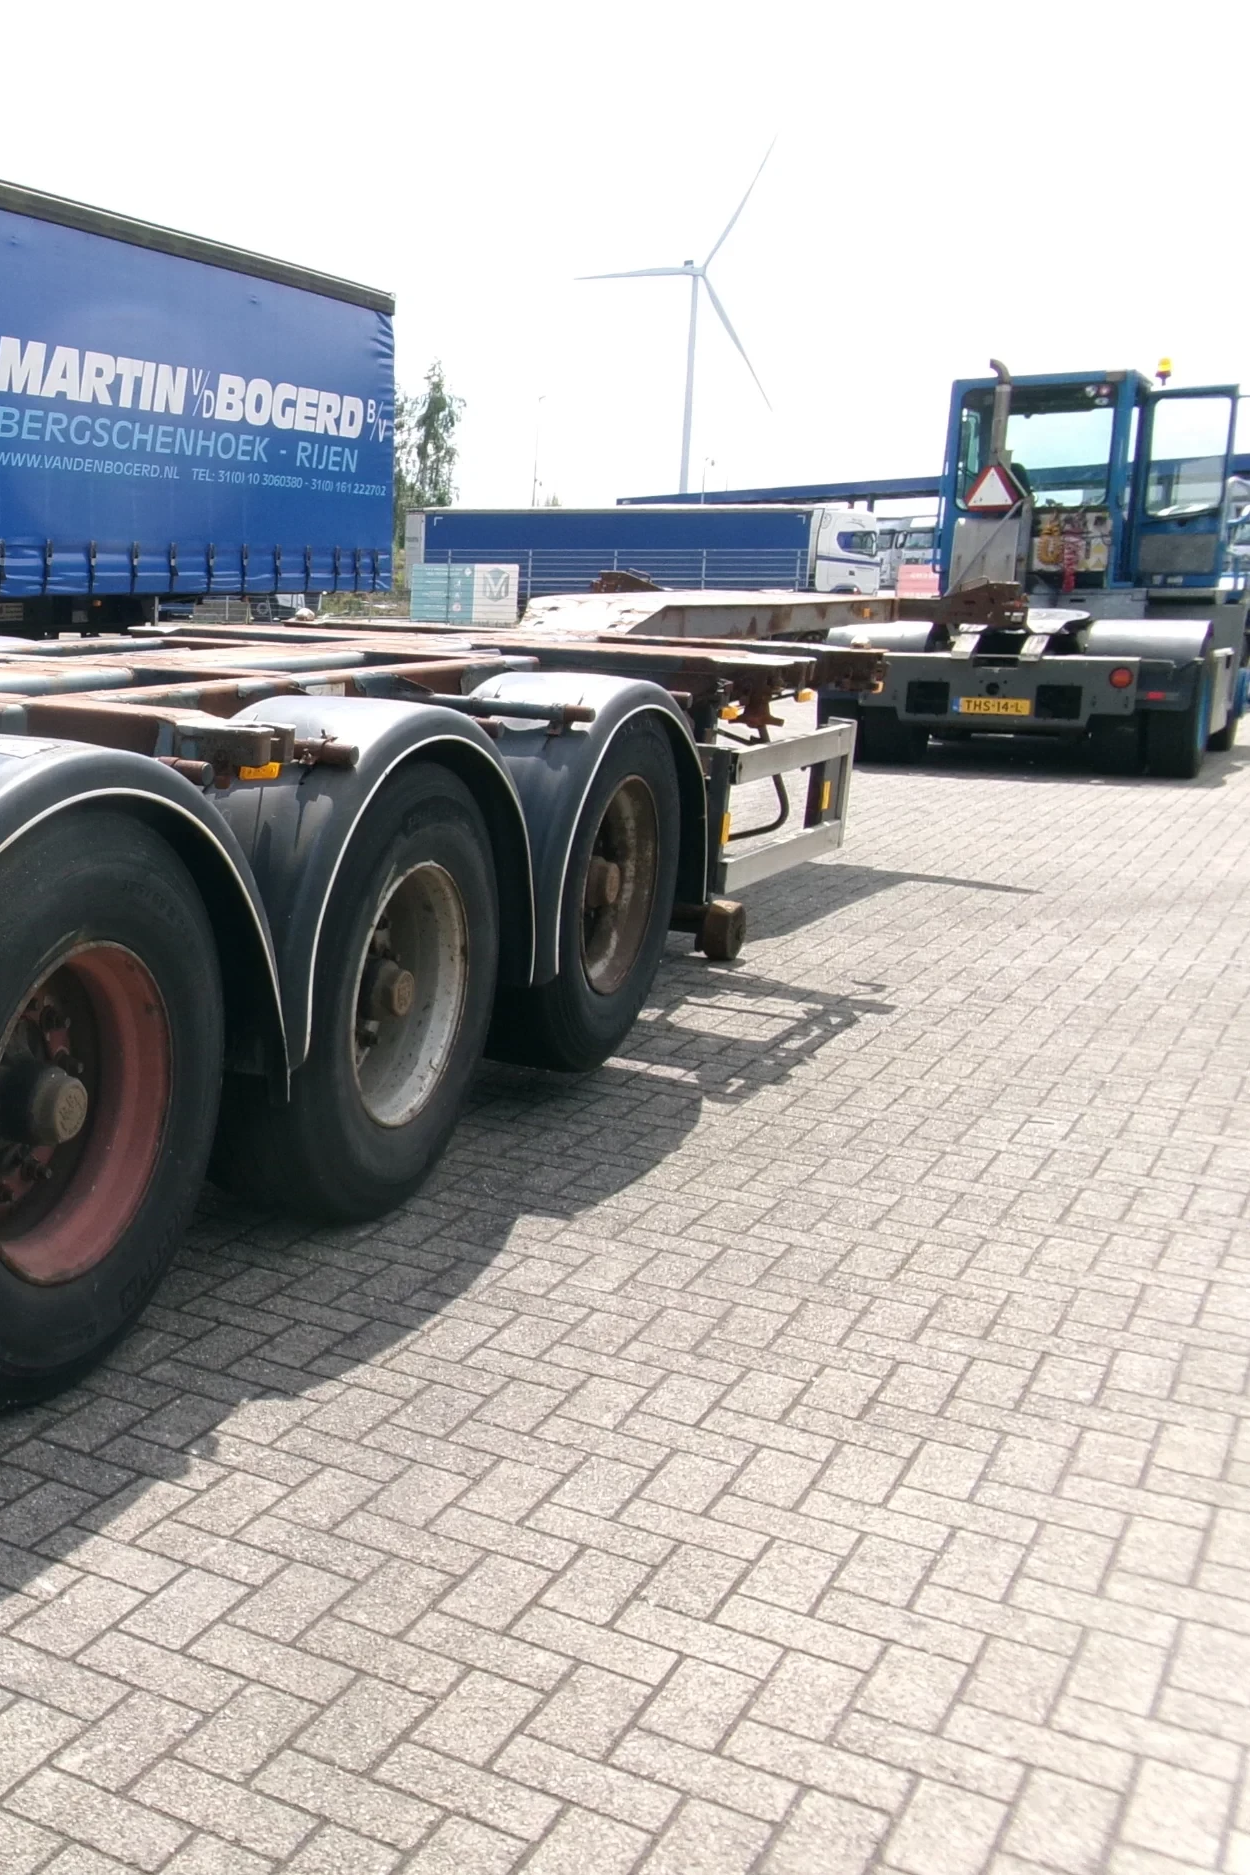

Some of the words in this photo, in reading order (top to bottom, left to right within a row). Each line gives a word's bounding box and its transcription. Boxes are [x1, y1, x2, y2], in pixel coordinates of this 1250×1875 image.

[215, 373, 364, 439] BOGERD
[296, 441, 358, 474] RIJEN
[191, 468, 216, 482] TEL:
[218, 470, 244, 484] 31(0)
[247, 473, 260, 485] 10
